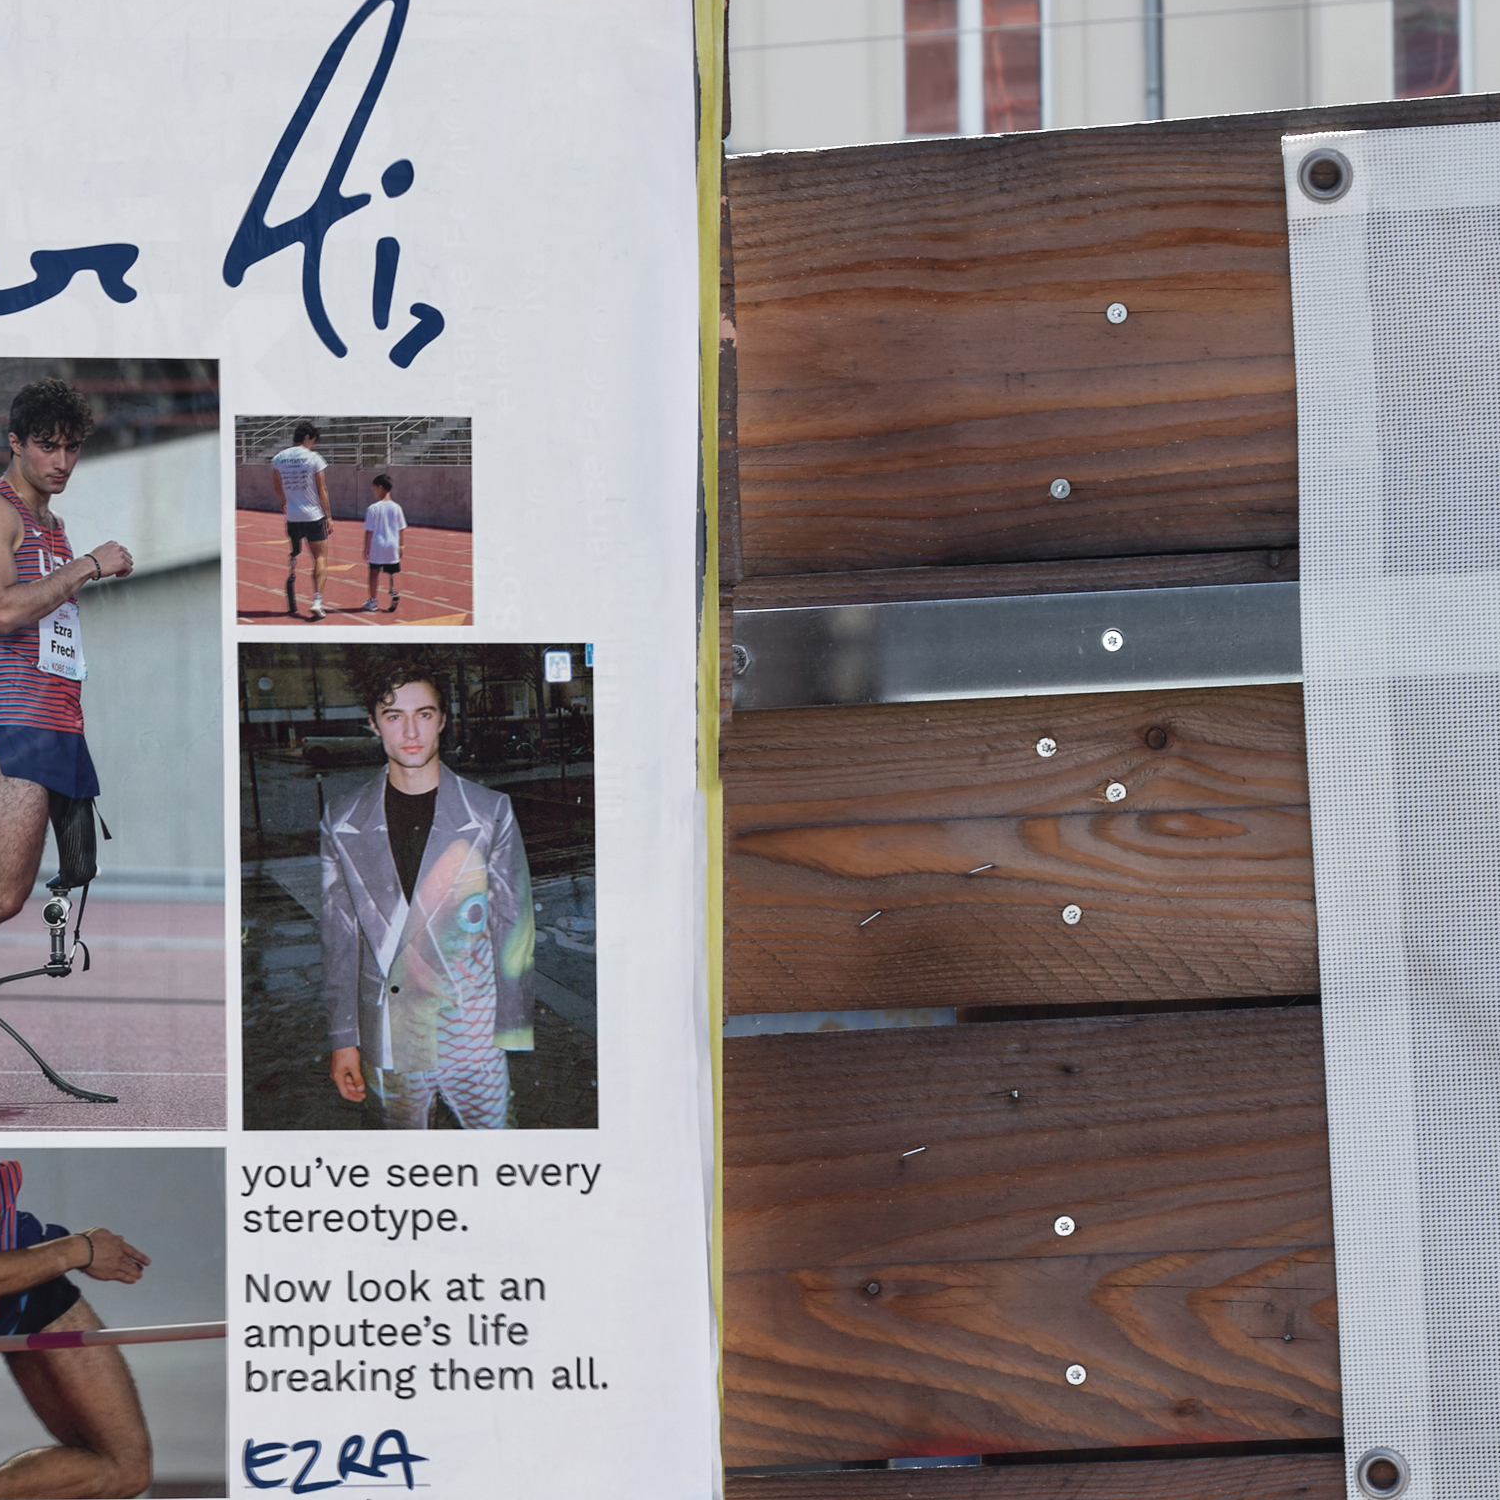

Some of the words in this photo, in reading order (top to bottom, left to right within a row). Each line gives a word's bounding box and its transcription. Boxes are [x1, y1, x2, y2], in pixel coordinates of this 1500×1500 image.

[54, 621, 72, 638] Ezra
[51, 640, 75, 659] Frech
[387, 1165, 477, 1187] seen
[497, 1164, 601, 1194] every
[244, 1205, 467, 1240] stereotype.
[246, 1274, 331, 1302] Now
[348, 1270, 430, 1302] look
[447, 1274, 484, 1301] at
[501, 1278, 544, 1300] an
[469, 1313, 528, 1345] life
[246, 1360, 416, 1399] breaking
[430, 1359, 532, 1390] them
[552, 1357, 607, 1389] all.
[243, 1429, 430, 1494] EZRA
